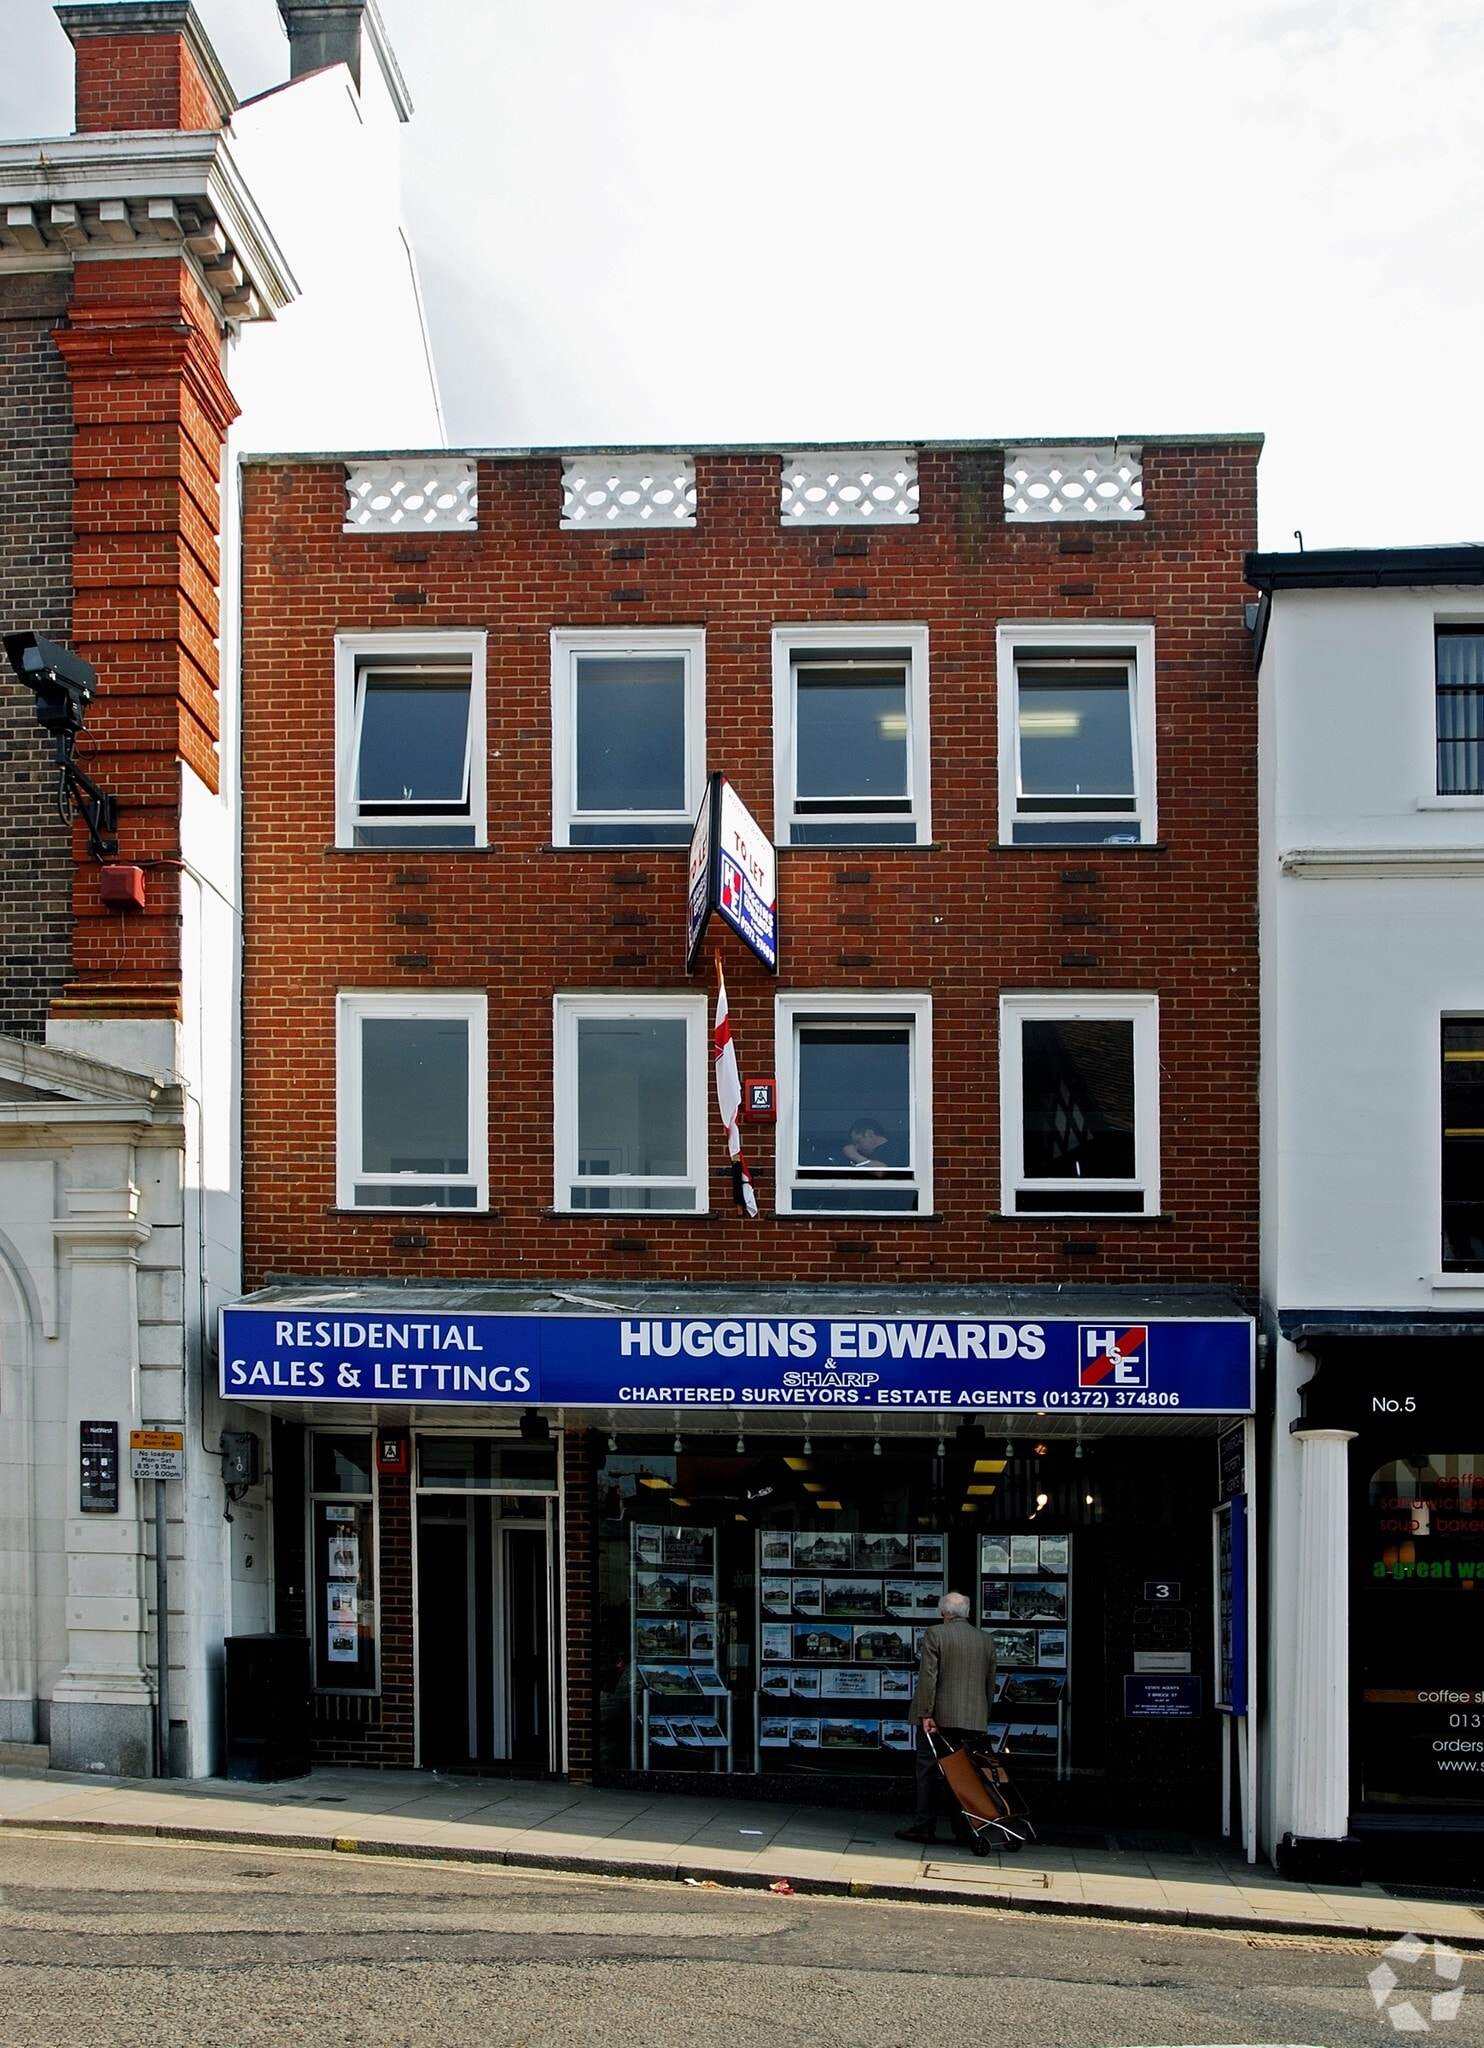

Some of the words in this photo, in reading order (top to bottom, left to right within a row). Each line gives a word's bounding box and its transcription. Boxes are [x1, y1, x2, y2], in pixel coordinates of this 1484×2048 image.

[733, 831, 748, 861] TO
[749, 857, 765, 887] LET
[275, 1321, 484, 1351] RESIDENTIAL
[620, 1321, 817, 1358] HUGGINS
[830, 1323, 1046, 1360] EDWARDS
[825, 1357, 837, 1369] &
[231, 1360, 324, 1387] SALES
[337, 1363, 362, 1388] &
[374, 1363, 531, 1392] LETTINGS
[783, 1371, 879, 1388] SHARP
[618, 1387, 736, 1403] CHARTERED
[741, 1388, 859, 1404] SURVEYORS
[878, 1389, 954, 1405] ESTATE
[958, 1391, 1037, 1406] AGENTS
[1042, 1391, 1110, 1409] (01372)
[1115, 1391, 1180, 1407] 374806
[1372, 1396, 1417, 1412] No.5
[1378, 1496, 1484, 1510] sandwiches
[1378, 1519, 1420, 1534] soup
[1373, 1561, 1386, 1578] a
[1391, 1559, 1453, 1580] great
[1155, 1584, 1170, 1598] 3
[1417, 1689, 1470, 1703] coffee
[1449, 1713, 1484, 1728] 013
[1432, 1738, 1484, 1752] orders
